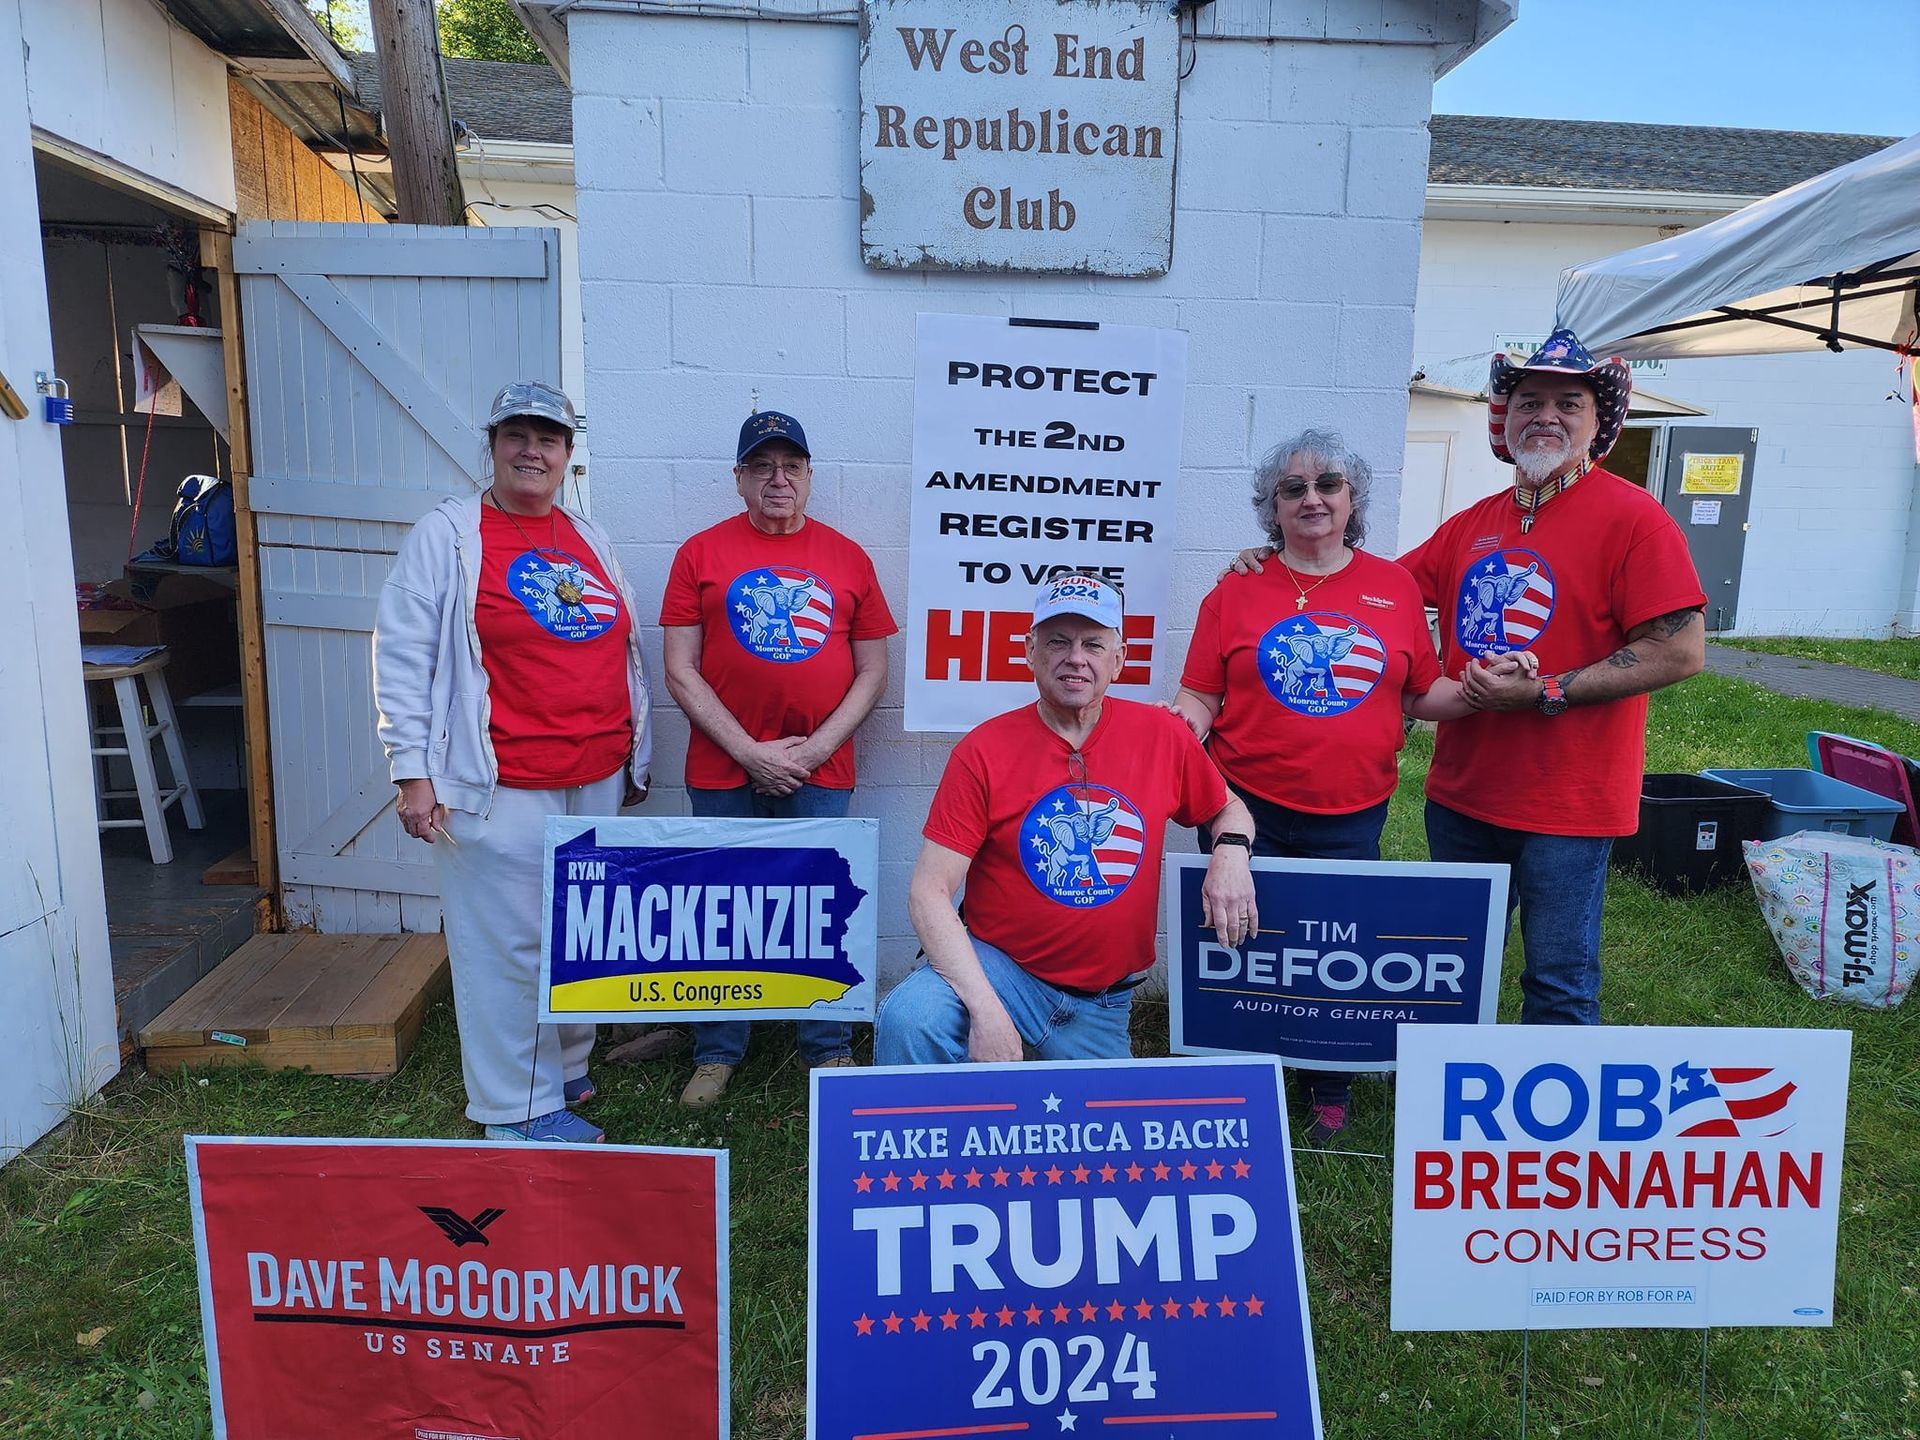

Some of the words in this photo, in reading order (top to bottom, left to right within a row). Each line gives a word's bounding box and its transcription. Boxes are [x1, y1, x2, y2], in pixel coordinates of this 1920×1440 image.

[896, 24, 1029, 76] West
[1053, 33, 1145, 81] End
[874, 105, 1164, 161] Republican
[963, 185, 1076, 231] Club
[948, 361, 1158, 396] PROTECT
[974, 428, 1037, 448] THE
[1043, 420, 1125, 452] 2ND
[925, 471, 1161, 499] AMENDMENT
[939, 512, 1154, 543] REGISTER
[958, 561, 1012, 583] TO
[1054, 577, 1101, 589] TRUMP
[1049, 585, 1100, 601] 2024
[581, 624, 603, 632] County
[755, 645, 783, 653] Monroe
[784, 646, 808, 656] County
[773, 652, 791, 660] GOP
[925, 609, 1155, 685] HEE
[1464, 640, 1488, 649] Monroe
[1288, 696, 1319, 705] Monroe
[1321, 698, 1349, 708] County
[1308, 705, 1328, 713] GOP
[567, 861, 606, 881] RYAN
[1053, 888, 1086, 896] Monroe
[1087, 888, 1115, 896] County
[1074, 896, 1095, 904] GOP
[565, 884, 836, 962] MACKENZIE
[1298, 920, 1357, 944] TIM
[629, 982, 666, 1002] U.S.
[673, 981, 763, 1006] Congress
[1233, 1000, 1320, 1018] AUDITOR
[1330, 1008, 1419, 1021] GENERAL
[1442, 1062, 1663, 1142] ROB
[853, 1127, 949, 1161] TAKE
[960, 1121, 1132, 1157] AMERICA
[1142, 1118, 1250, 1151] BACK!
[1414, 1150, 1823, 1210] BRESNAHAN
[852, 1193, 1257, 1296] TRUMP
[1464, 1227, 1767, 1264] CONGRESS
[247, 1252, 368, 1310] DAVE
[1535, 1291, 1566, 1304] PAID
[1568, 1291, 1594, 1303] FOR
[1598, 1291, 1615, 1302] BY
[1617, 1290, 1644, 1302] ROB
[1647, 1290, 1673, 1302] FOR
[1677, 1290, 1693, 1302] PA
[364, 1332, 406, 1355] US
[427, 1338, 570, 1365] SENATE
[971, 1332, 1157, 1409] 2024
